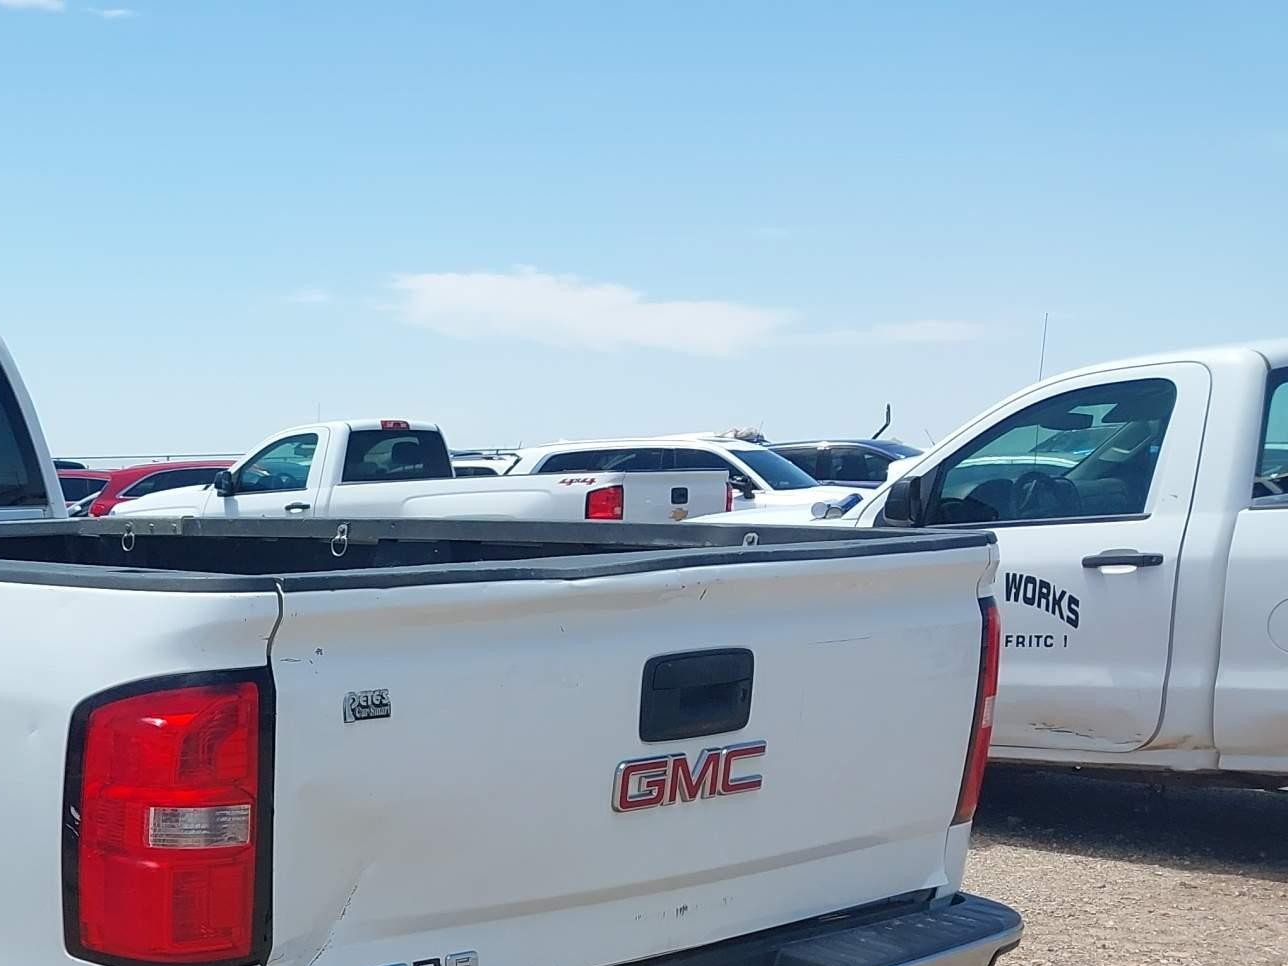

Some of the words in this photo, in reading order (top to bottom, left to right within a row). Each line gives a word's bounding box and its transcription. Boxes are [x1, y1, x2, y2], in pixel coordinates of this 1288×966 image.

[559, 477, 596, 486] 4x4
[1005, 572, 1080, 629] WORKS
[612, 740, 767, 812] GMC
